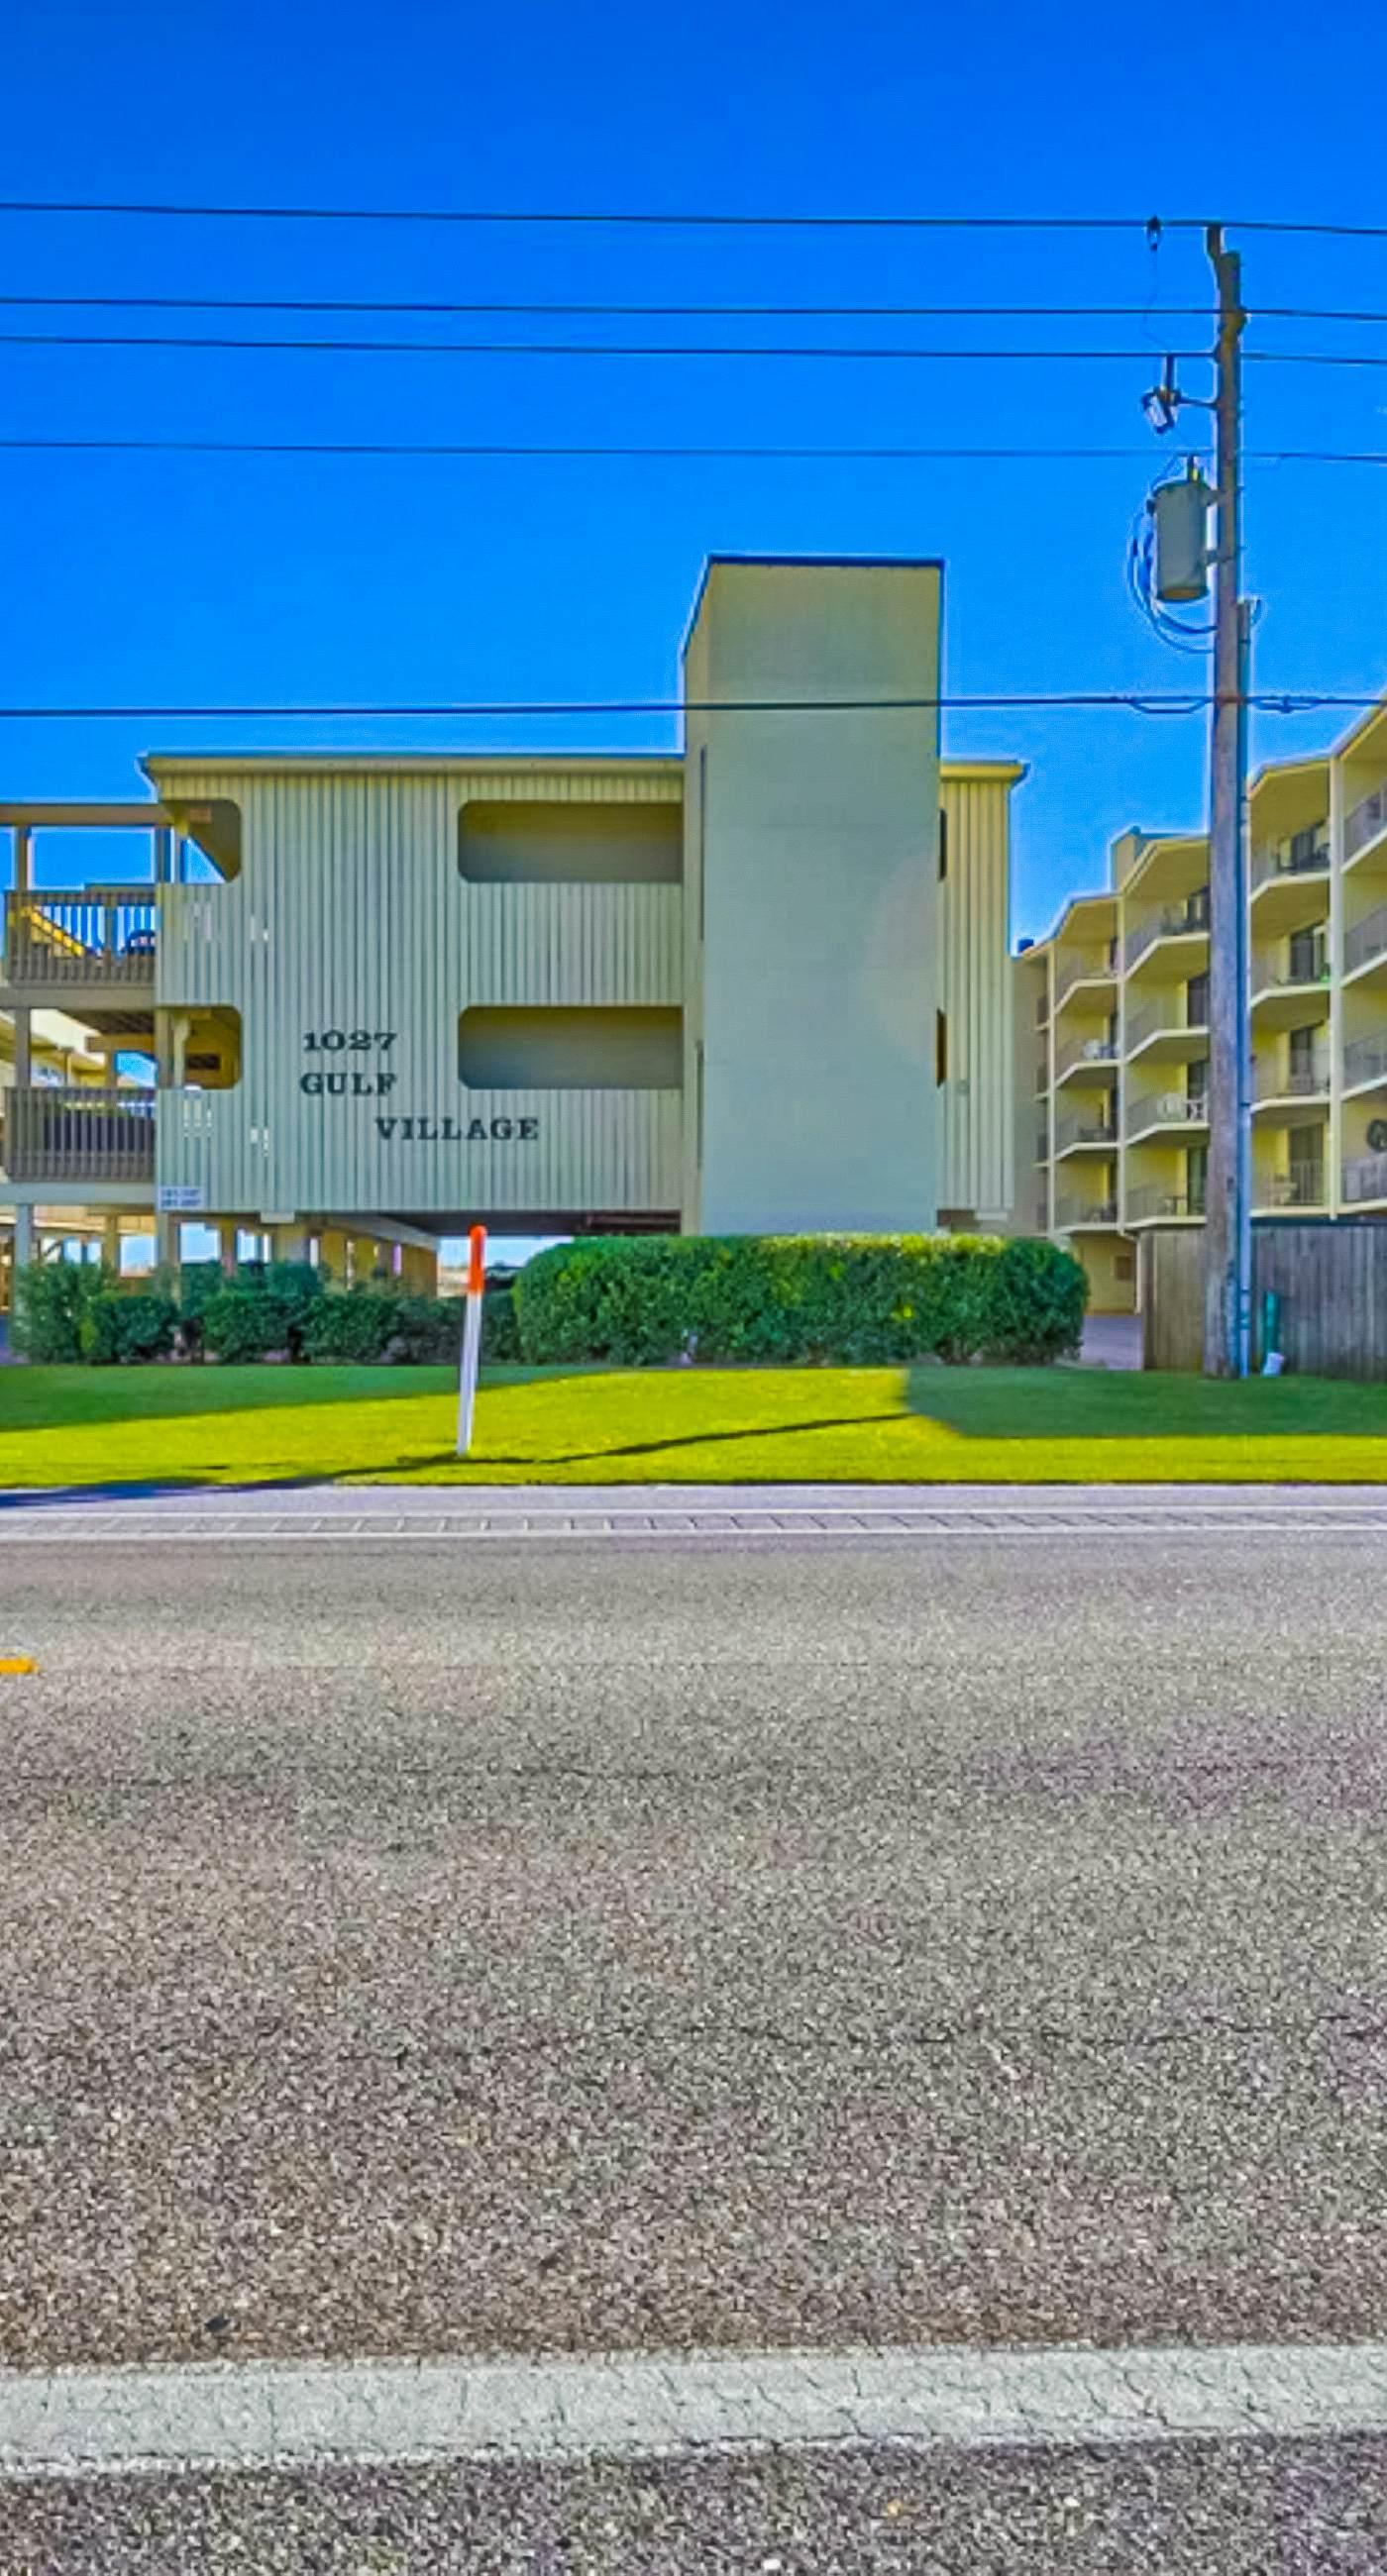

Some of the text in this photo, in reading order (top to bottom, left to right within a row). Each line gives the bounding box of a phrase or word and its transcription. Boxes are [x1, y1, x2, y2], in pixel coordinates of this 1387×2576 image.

[303, 1030, 397, 1052] 1027
[300, 1073, 396, 1095] GULF
[374, 1116, 539, 1141] VILLAGE
